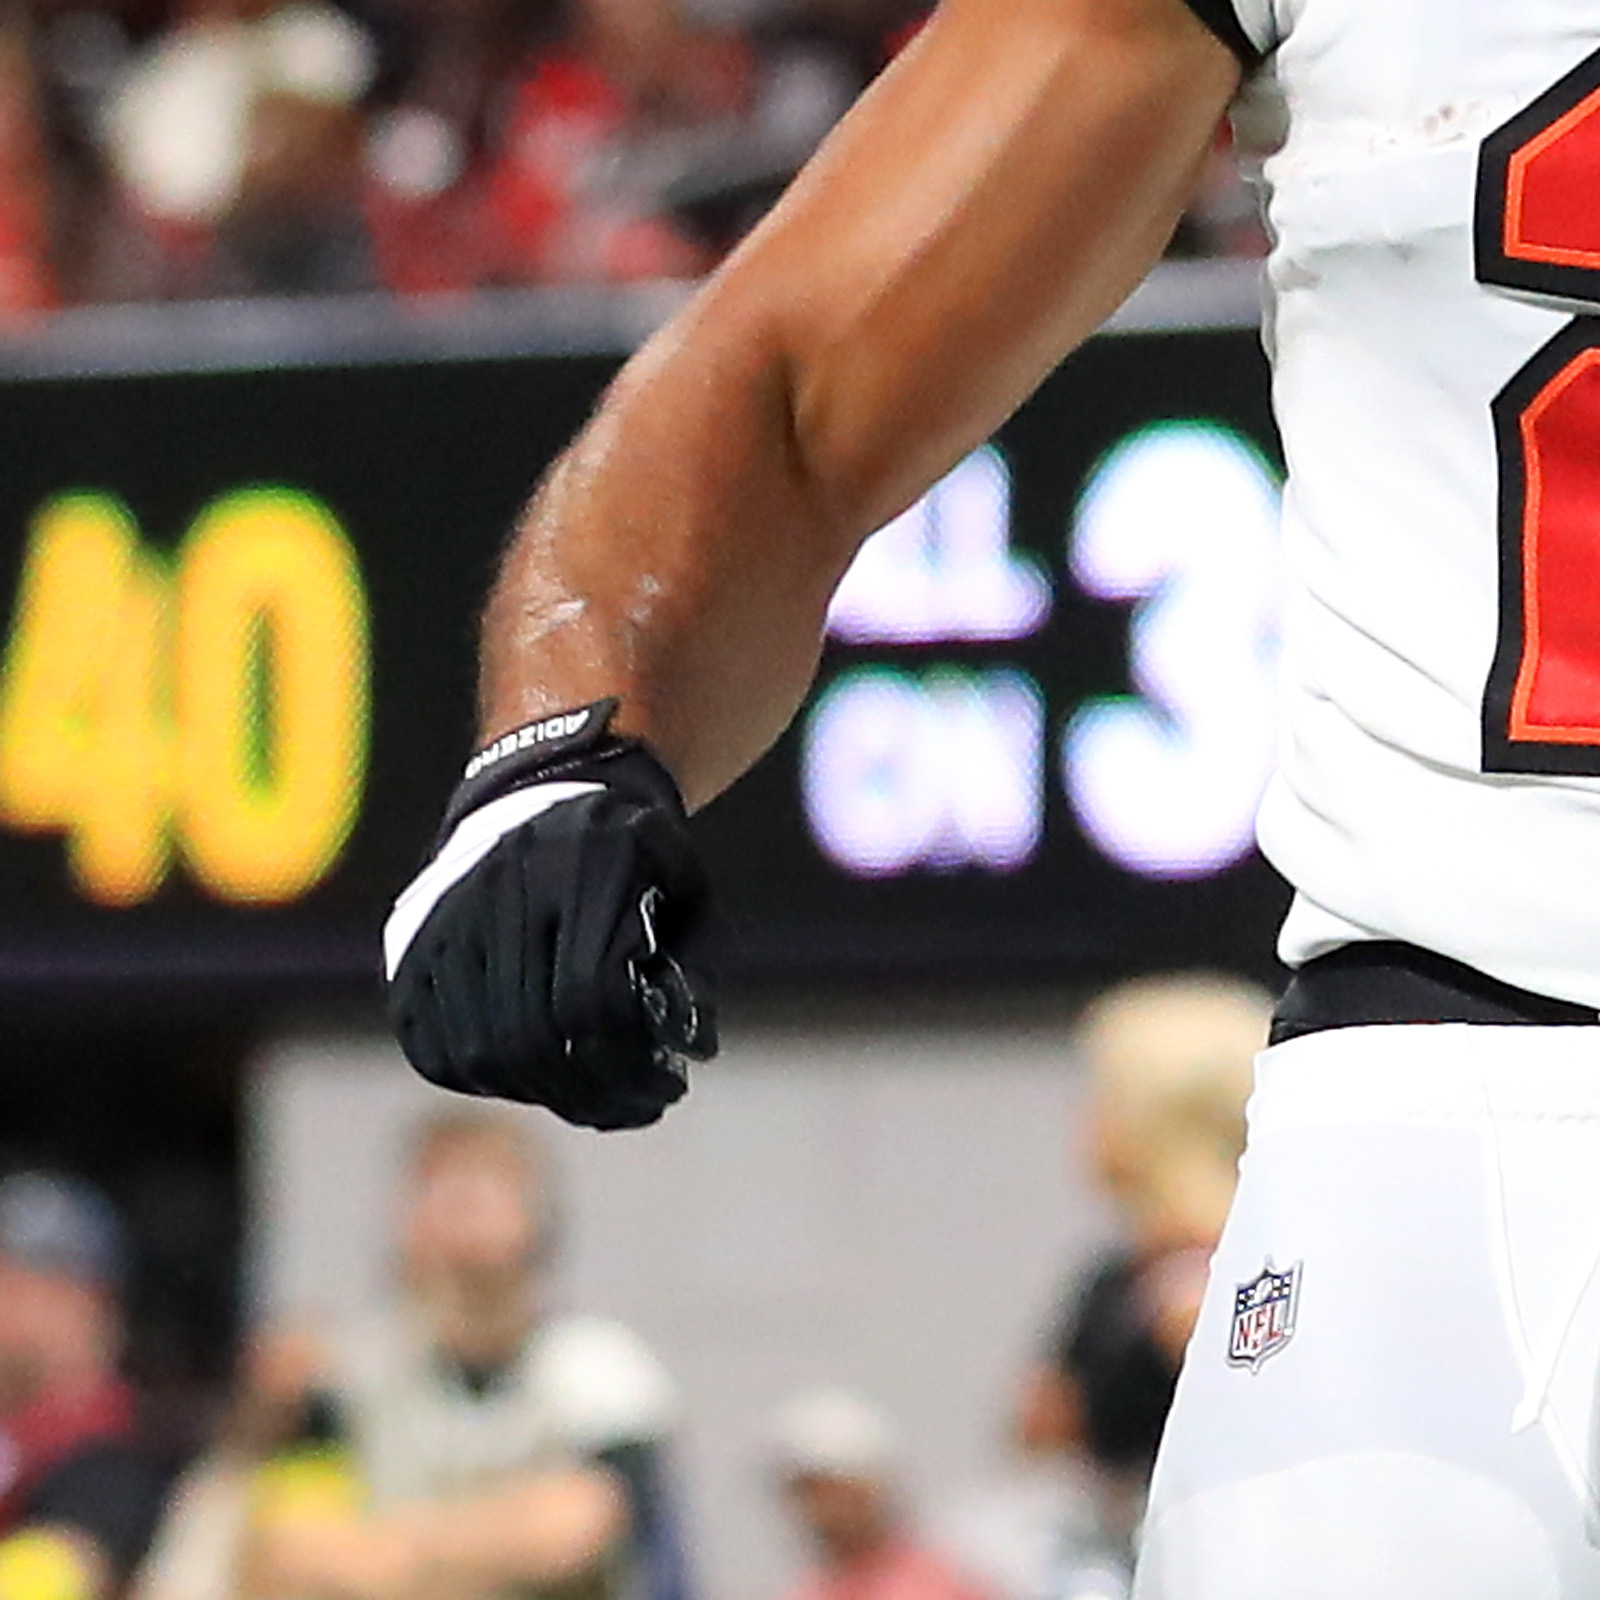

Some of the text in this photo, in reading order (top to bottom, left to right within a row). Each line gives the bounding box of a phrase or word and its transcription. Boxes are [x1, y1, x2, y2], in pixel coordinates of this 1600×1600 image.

[0, 485, 370, 905] 40
[1062, 420, 1287, 880] 3
[1235, 1303, 1283, 1351] NFL
